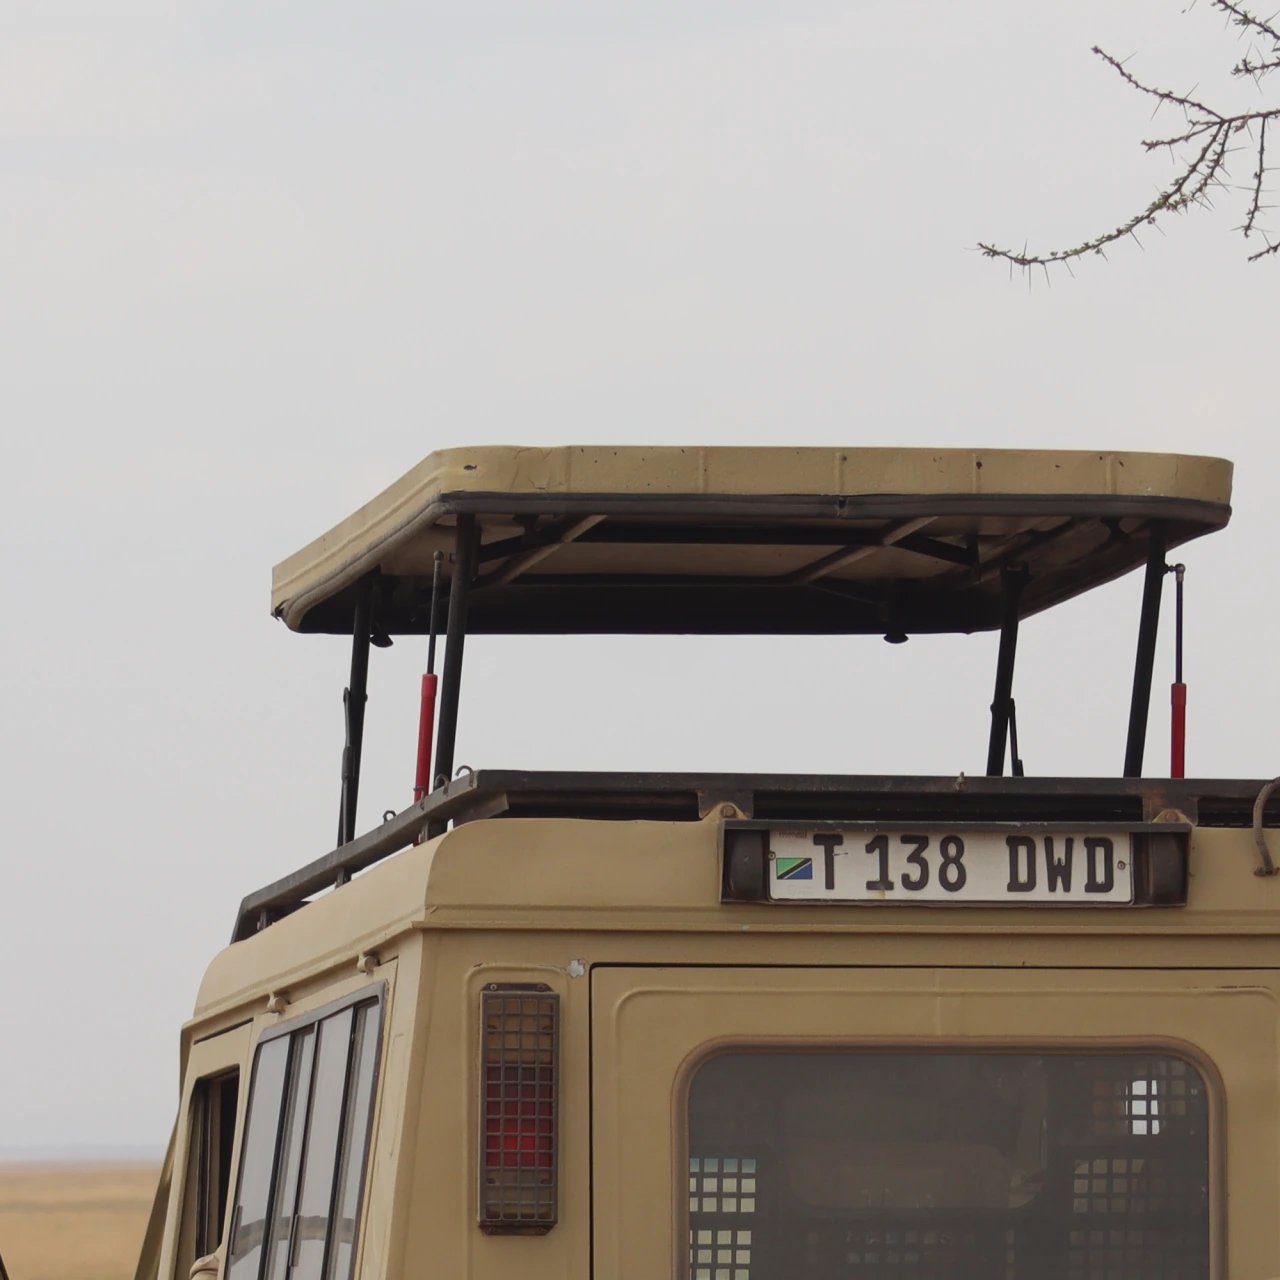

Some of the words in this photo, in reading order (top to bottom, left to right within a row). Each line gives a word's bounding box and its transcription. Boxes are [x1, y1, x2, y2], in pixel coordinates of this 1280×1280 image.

[812, 833, 844, 890] T
[864, 834, 968, 892] 138
[1006, 836, 1115, 894] DWD
